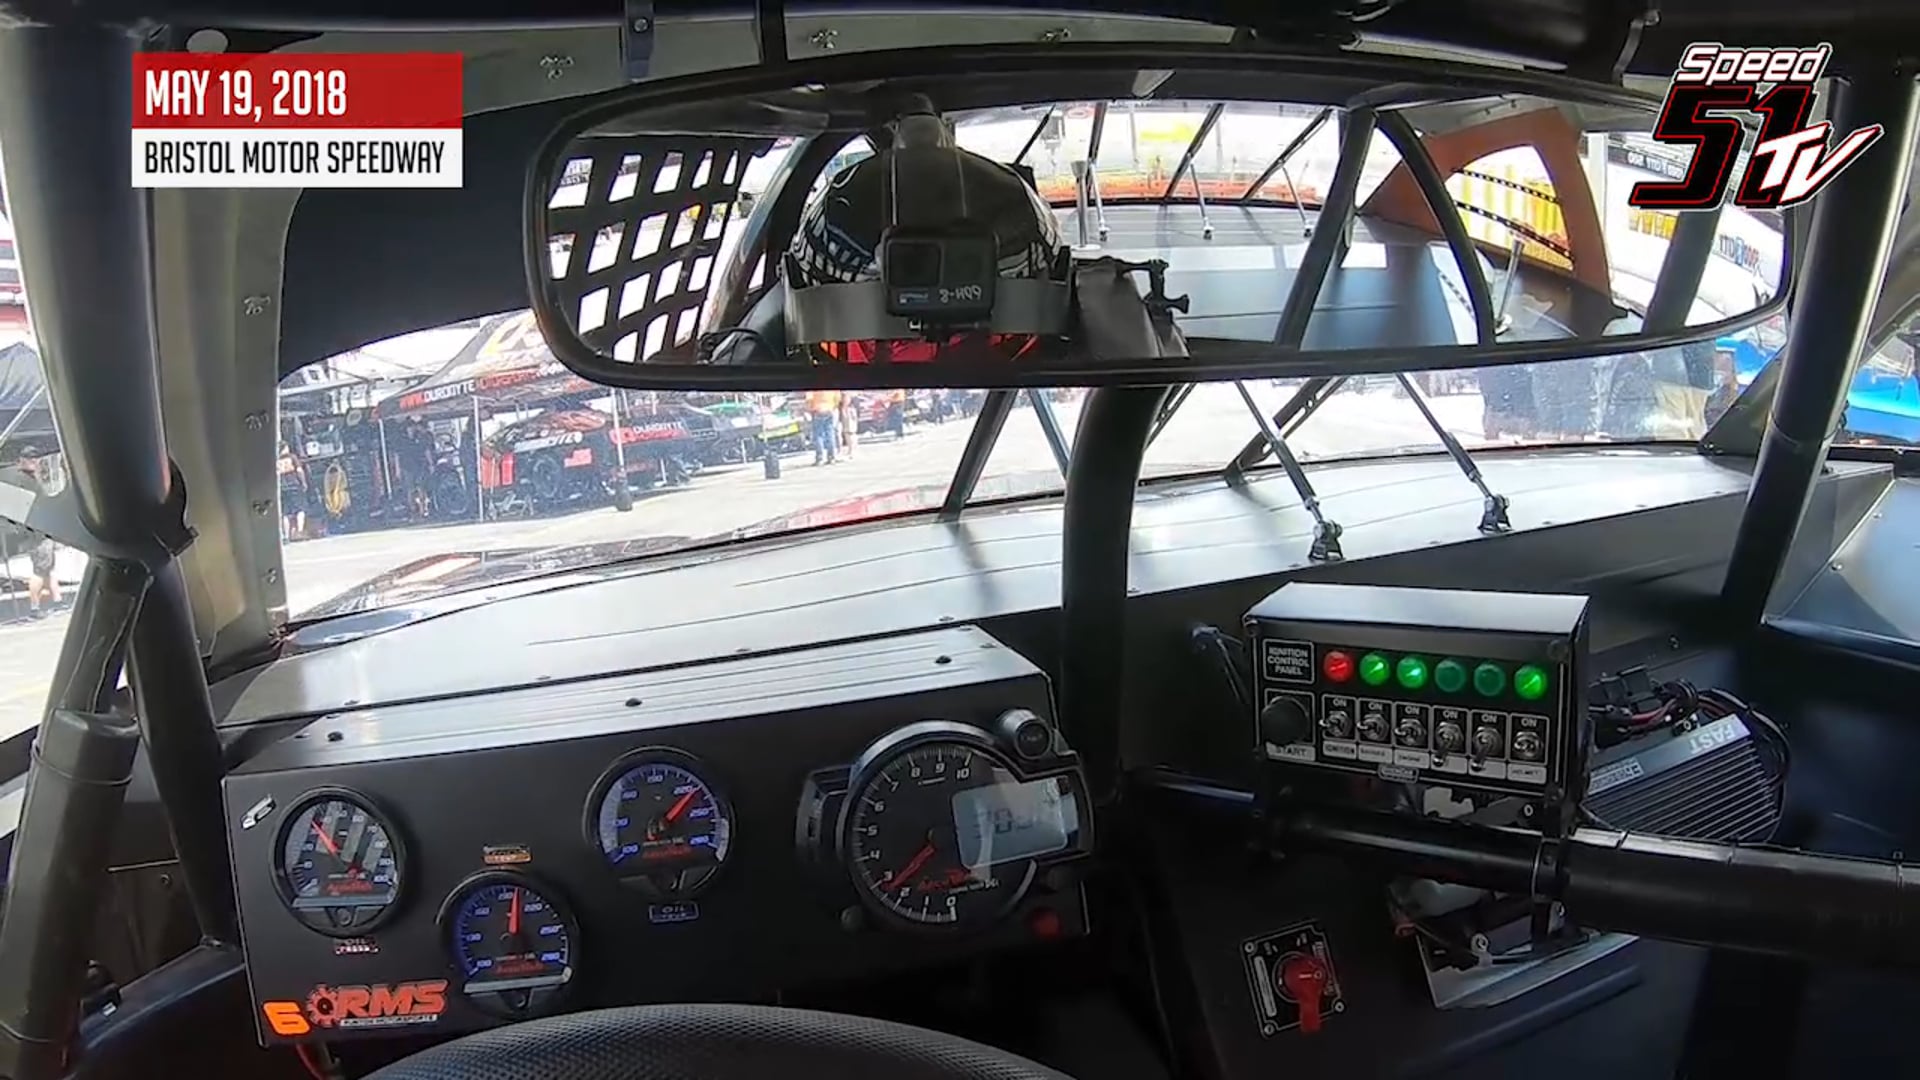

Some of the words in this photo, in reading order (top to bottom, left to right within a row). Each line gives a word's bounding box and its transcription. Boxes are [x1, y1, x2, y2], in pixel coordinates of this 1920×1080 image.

[1268, 646, 1308, 658] IGNITION
[1267, 655, 1310, 668] CONTROL
[1274, 664, 1303, 675] PANEL
[1333, 697, 1347, 707] ON
[1368, 701, 1383, 711] ON
[1405, 705, 1419, 715] ON
[1443, 709, 1458, 719] ON
[1481, 713, 1497, 724] ON
[1521, 717, 1537, 727] ON
[1689, 723, 1735, 755] FAST
[911, 767, 921, 778] 8
[935, 762, 945, 774] 9
[956, 767, 970, 779] 10
[890, 780, 900, 793] 7
[873, 801, 885, 813] 6
[867, 824, 878, 836] 5
[869, 849, 881, 860] 4
[900, 886, 911, 897] 2
[946, 895, 957, 907] 0
[337, 979, 448, 1018] RMS
[263, 1001, 310, 1036] 6
